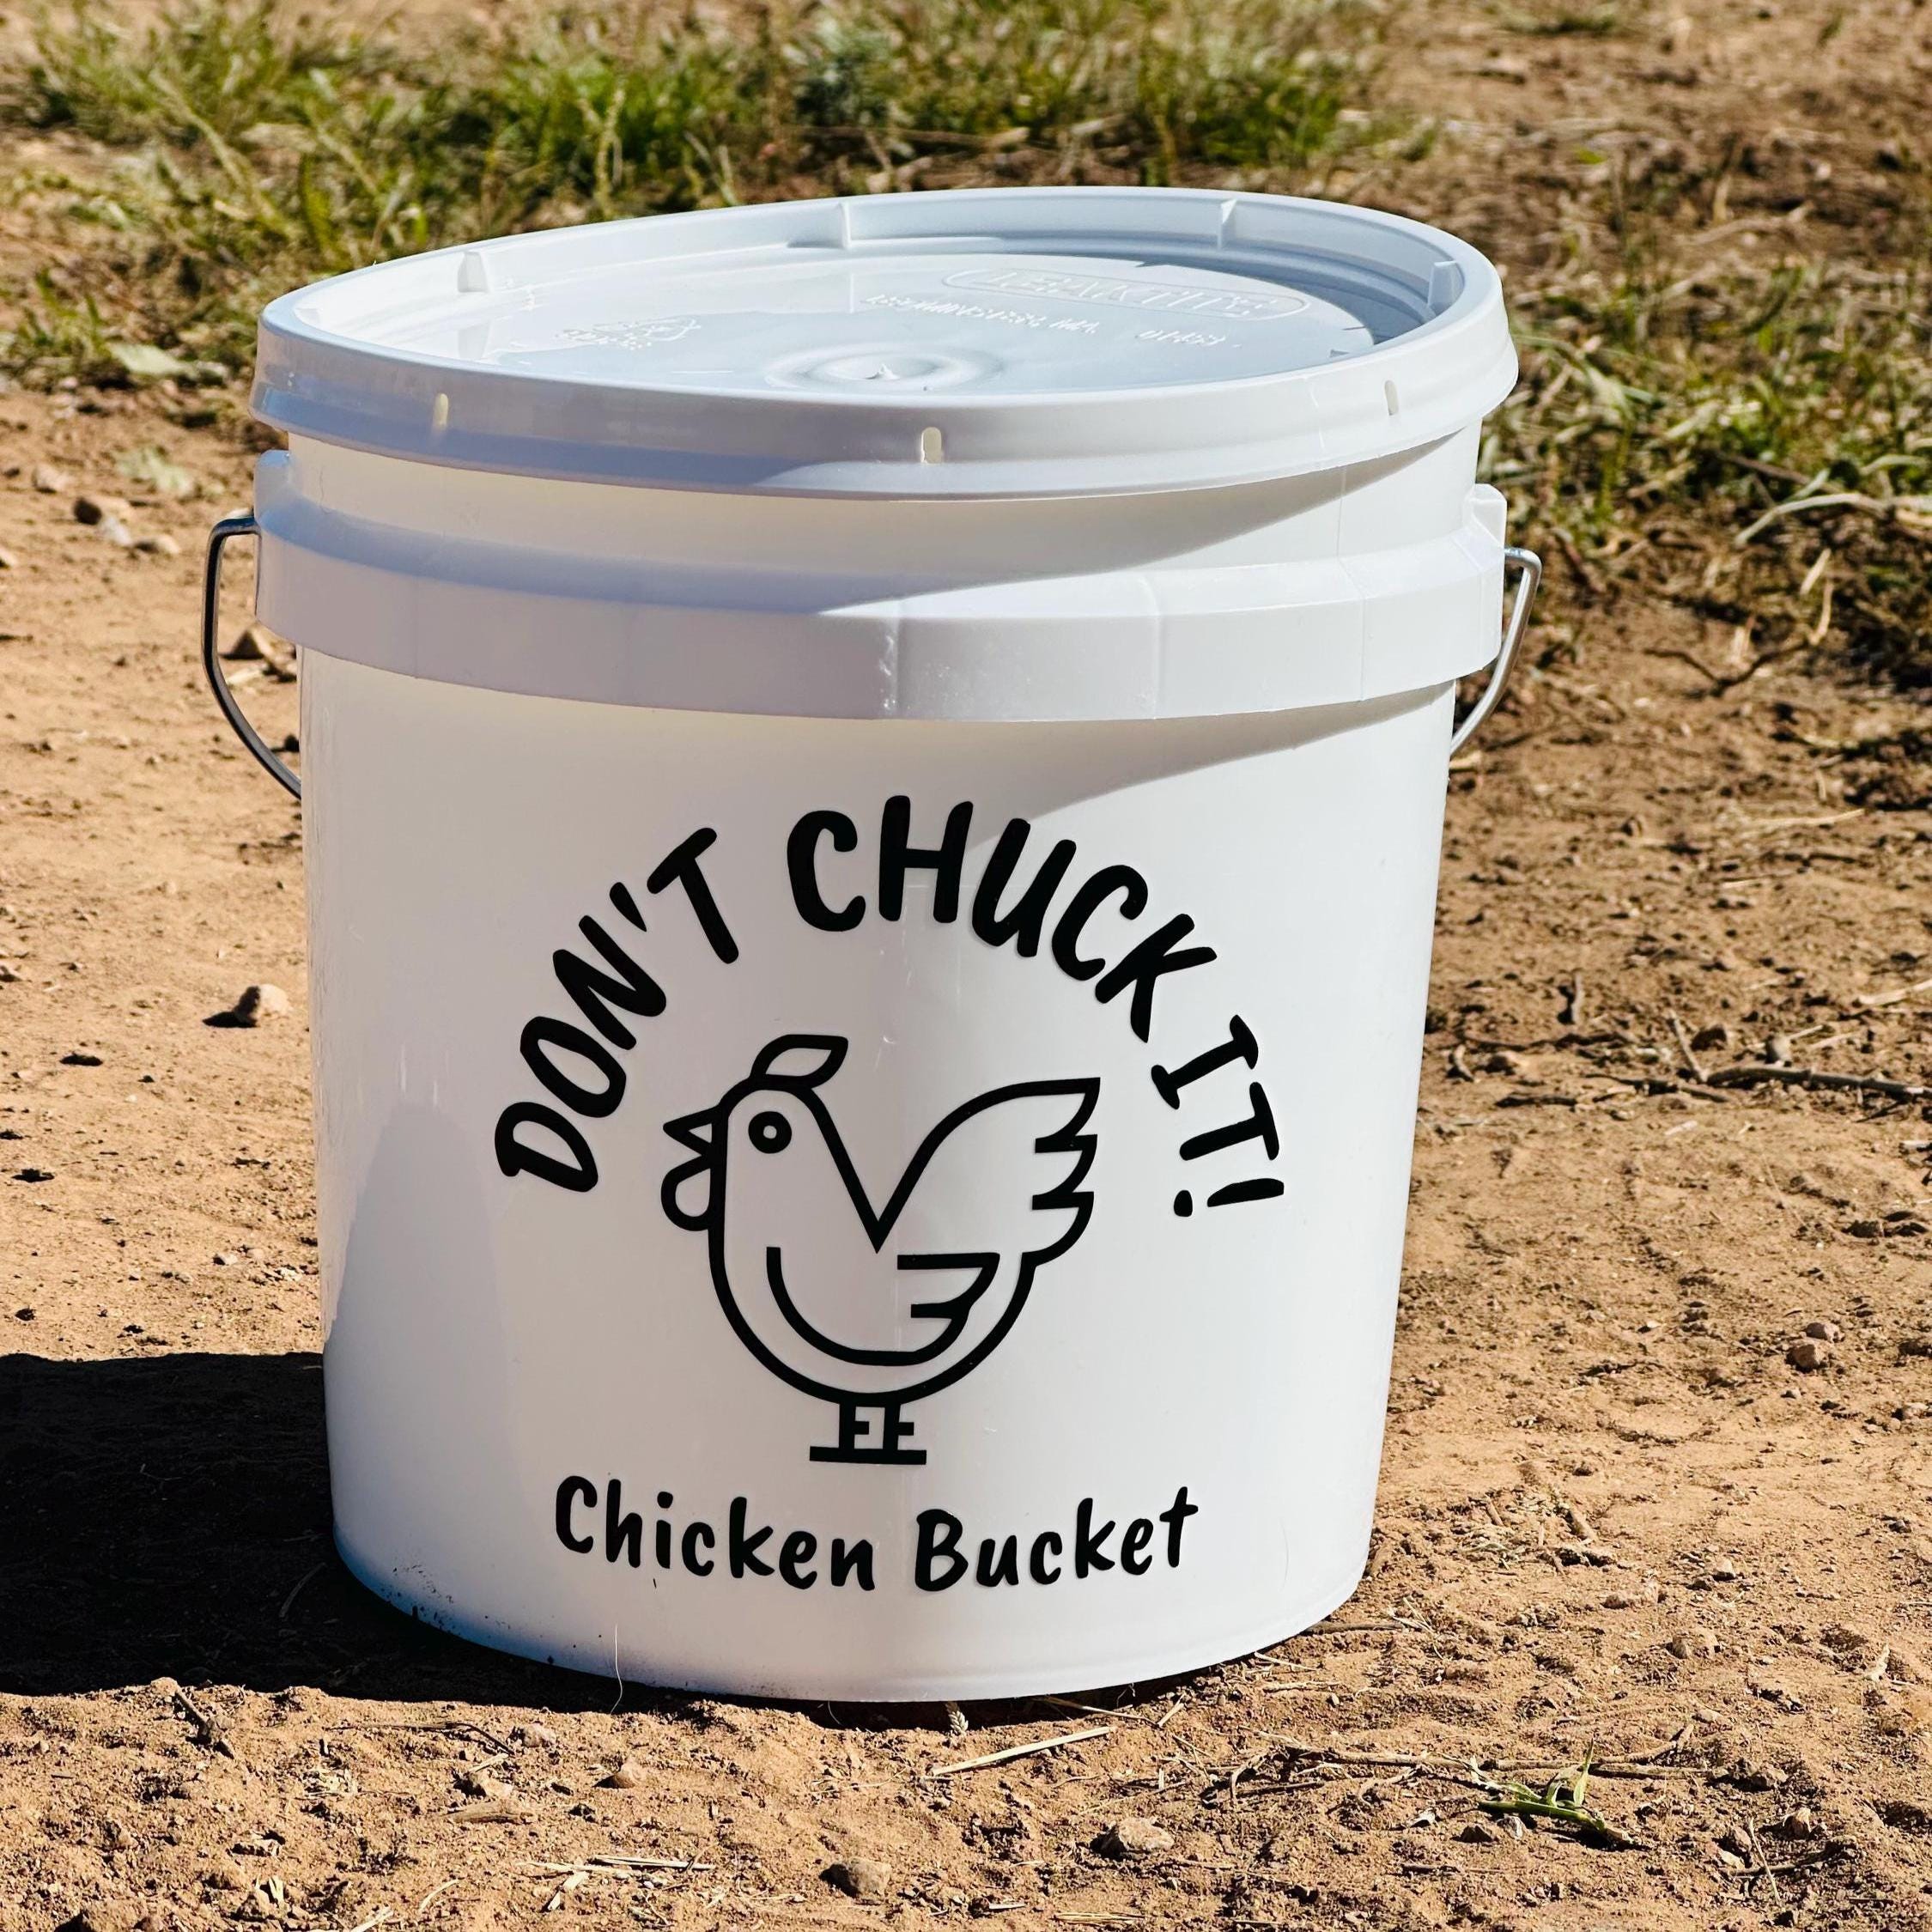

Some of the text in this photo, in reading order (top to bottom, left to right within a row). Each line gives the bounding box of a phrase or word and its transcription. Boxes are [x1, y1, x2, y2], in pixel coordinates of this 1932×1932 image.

[495, 794, 1285, 1218] DON'T CHUCK IT!
[555, 1475, 1199, 1592] Chicken Bucket
